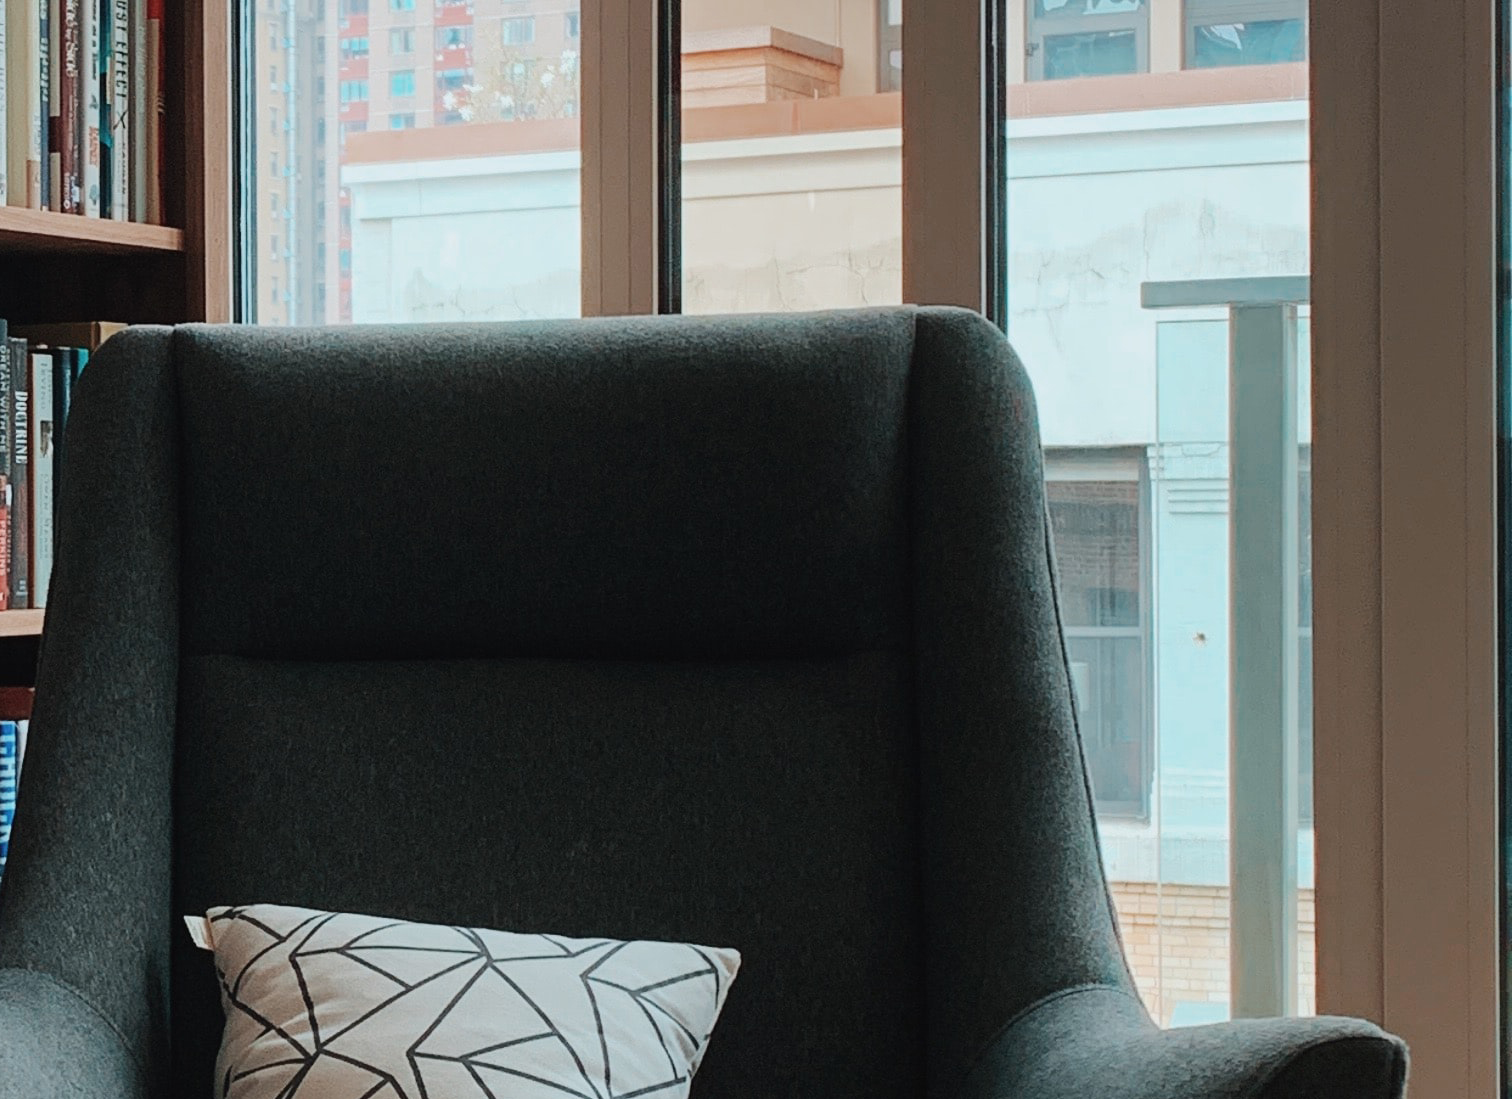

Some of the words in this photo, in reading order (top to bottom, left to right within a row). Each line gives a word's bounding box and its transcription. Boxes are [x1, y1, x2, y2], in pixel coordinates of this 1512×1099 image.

[116, 41, 127, 98] EFFECT
[0, 396, 7, 430] WITH
[14, 391, 28, 464] DOCTRINE
[0, 435, 7, 453] ME
